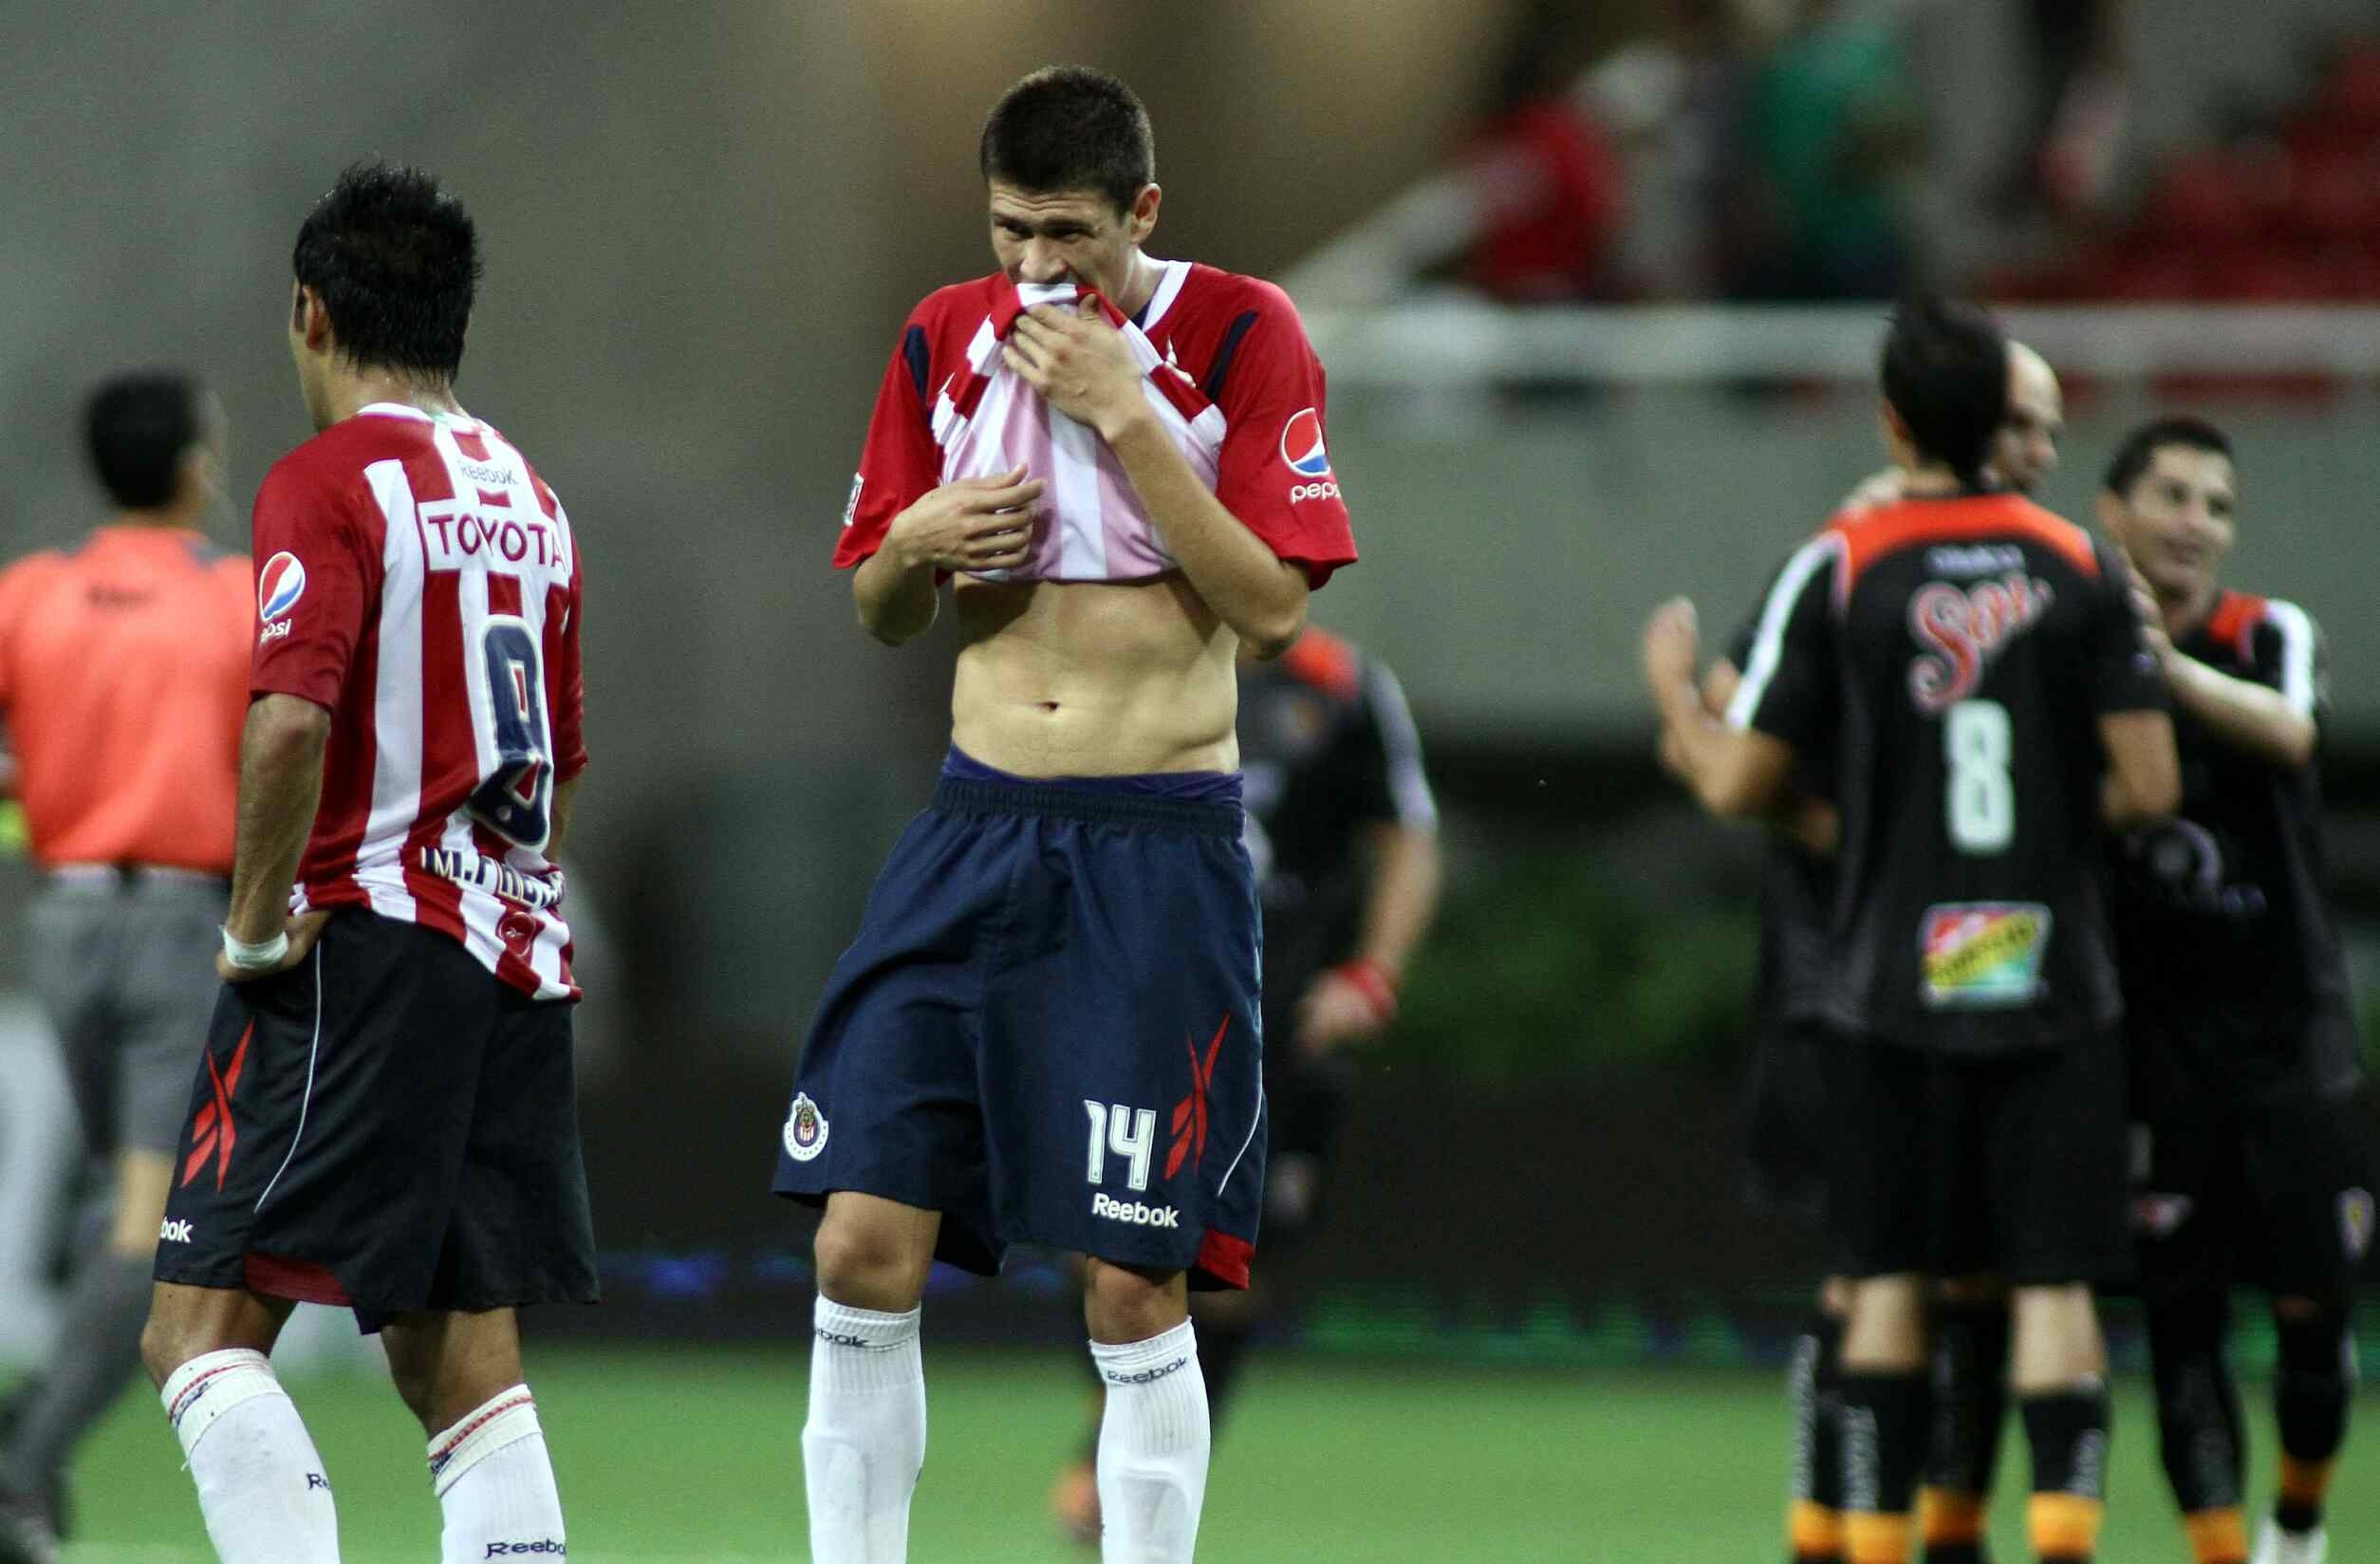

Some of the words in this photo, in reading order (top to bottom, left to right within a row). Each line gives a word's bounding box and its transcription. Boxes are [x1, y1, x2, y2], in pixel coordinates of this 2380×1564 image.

[427, 514, 567, 569] TOYOTA
[1947, 699, 2013, 849] 8
[1084, 1099, 1157, 1191] 14
[1091, 1192, 1180, 1228] Reebok
[159, 1216, 194, 1243] bok
[813, 1328, 869, 1348] bok
[484, 1538, 567, 1559] Reebo
